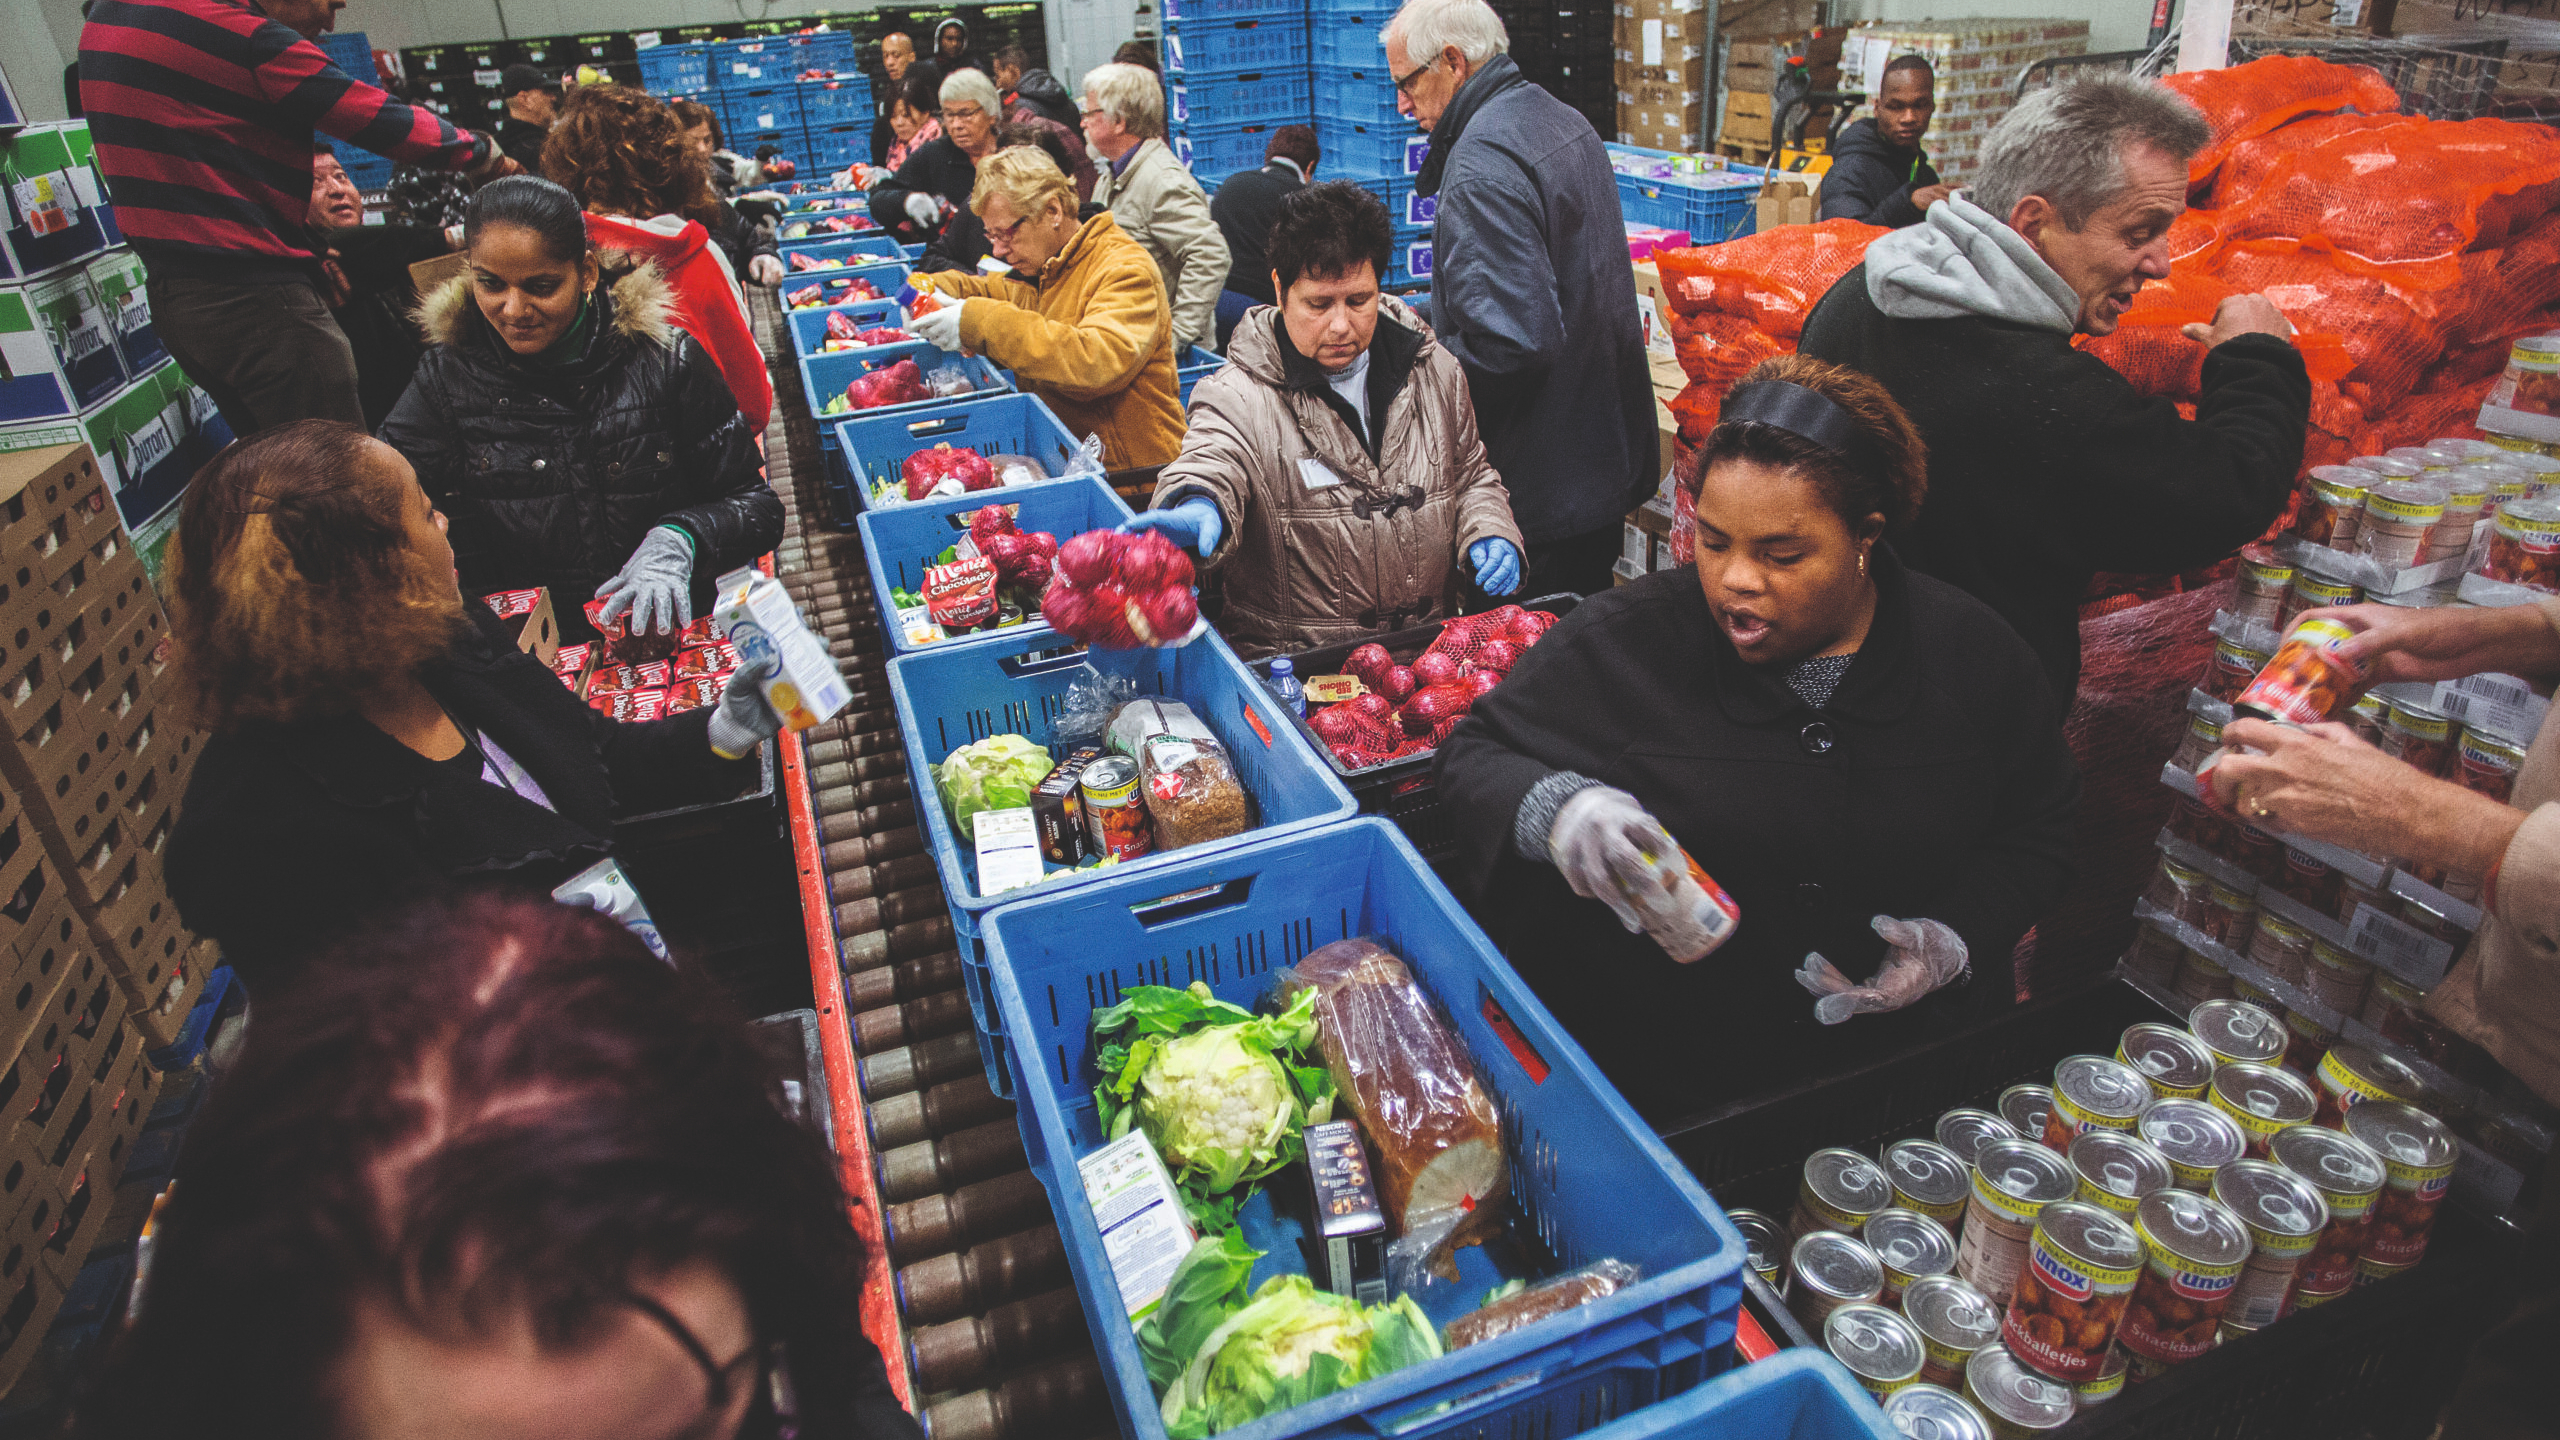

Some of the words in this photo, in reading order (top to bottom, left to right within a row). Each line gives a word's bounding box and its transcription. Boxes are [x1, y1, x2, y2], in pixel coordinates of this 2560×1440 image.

[133, 427, 169, 466] DUTOIT
[929, 556, 988, 587] Mona
[931, 570, 991, 596] Chocolade
[636, 660, 668, 687] Mona
[1318, 680, 1352, 691] ONIONS
[1336, 685, 1352, 695] RED
[633, 690, 665, 722] Mona
[2349, 1079, 2360, 1089] 20
[2036, 1246, 2087, 1291] unox
[2181, 1272, 2237, 1289] unox
